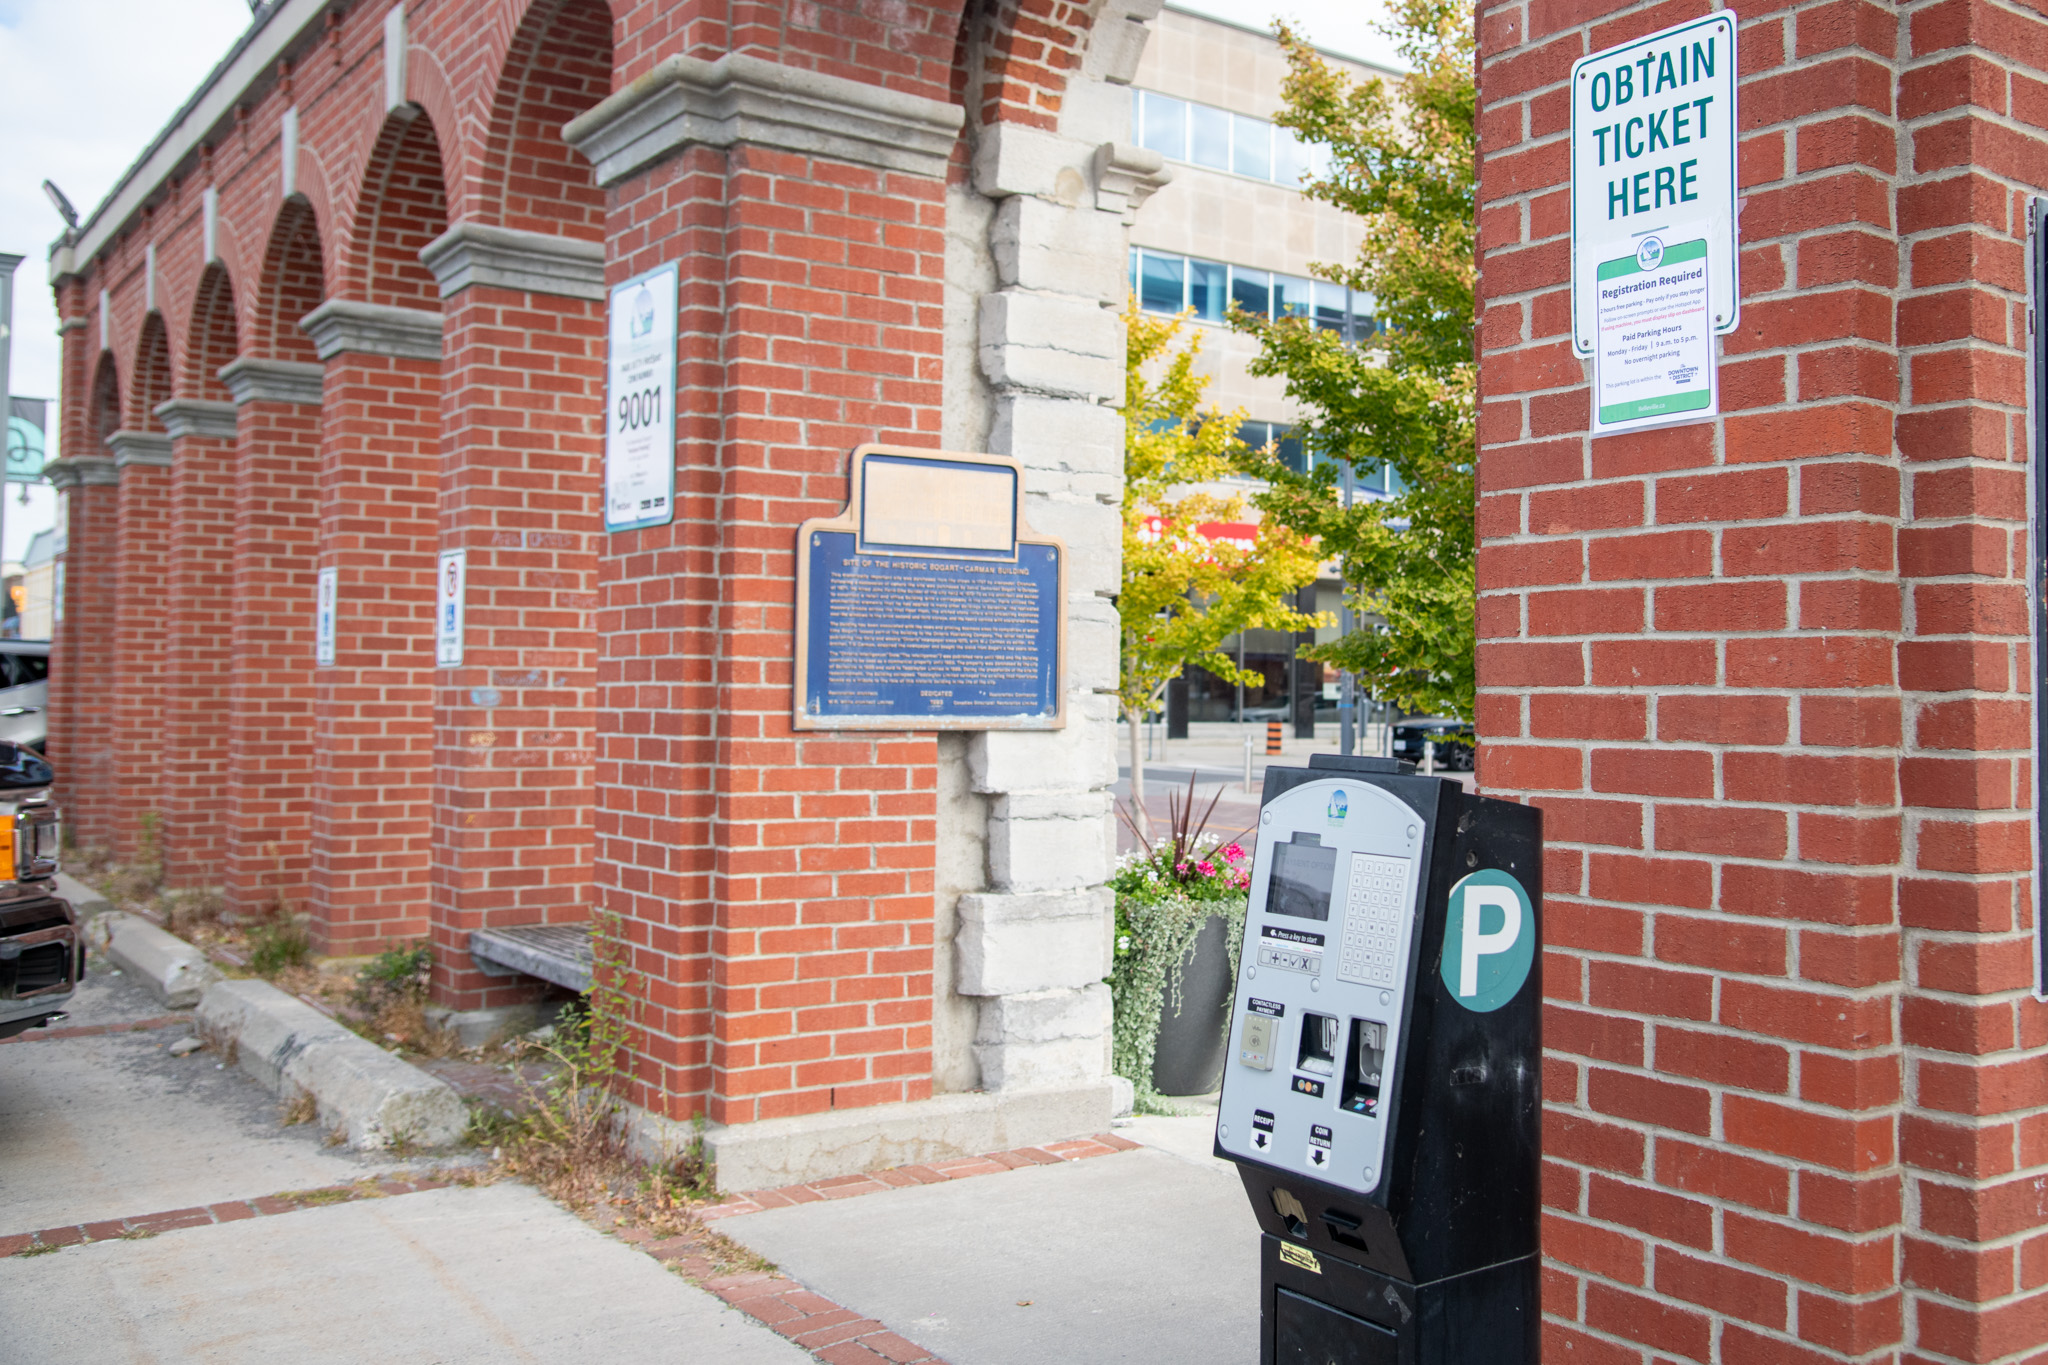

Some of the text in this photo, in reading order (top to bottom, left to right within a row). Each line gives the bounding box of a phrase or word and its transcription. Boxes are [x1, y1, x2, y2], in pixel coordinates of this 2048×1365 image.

[1591, 37, 1714, 112] OBTAIN
[1593, 96, 1713, 166] TICKET
[1608, 158, 1698, 220] HERE
[1602, 268, 1702, 299] Registration Required
[1626, 301, 1642, 309] parking
[1622, 325, 1682, 342] Paid Parking Hours
[1608, 348, 1628, 357] Monday
[1633, 354, 1658, 364] overnight
[1659, 350, 1680, 359] parking
[1668, 366, 1698, 376] DOWNTOWN
[618, 385, 661, 434] 9001
[843, 559, 859, 567] SITE
[892, 562, 927, 570] HISTORIC
[998, 567, 1029, 576] BUILDING
[1278, 931, 1289, 939] Press
[1459, 885, 1522, 997] P
[1252, 999, 1281, 1010] CONTACTLESS
[1256, 1006, 1275, 1014] PAYMENT
[1254, 1114, 1274, 1126] RECEIPT
[1315, 1126, 1328, 1136] COIN
[1310, 1136, 1331, 1148] RETURN
